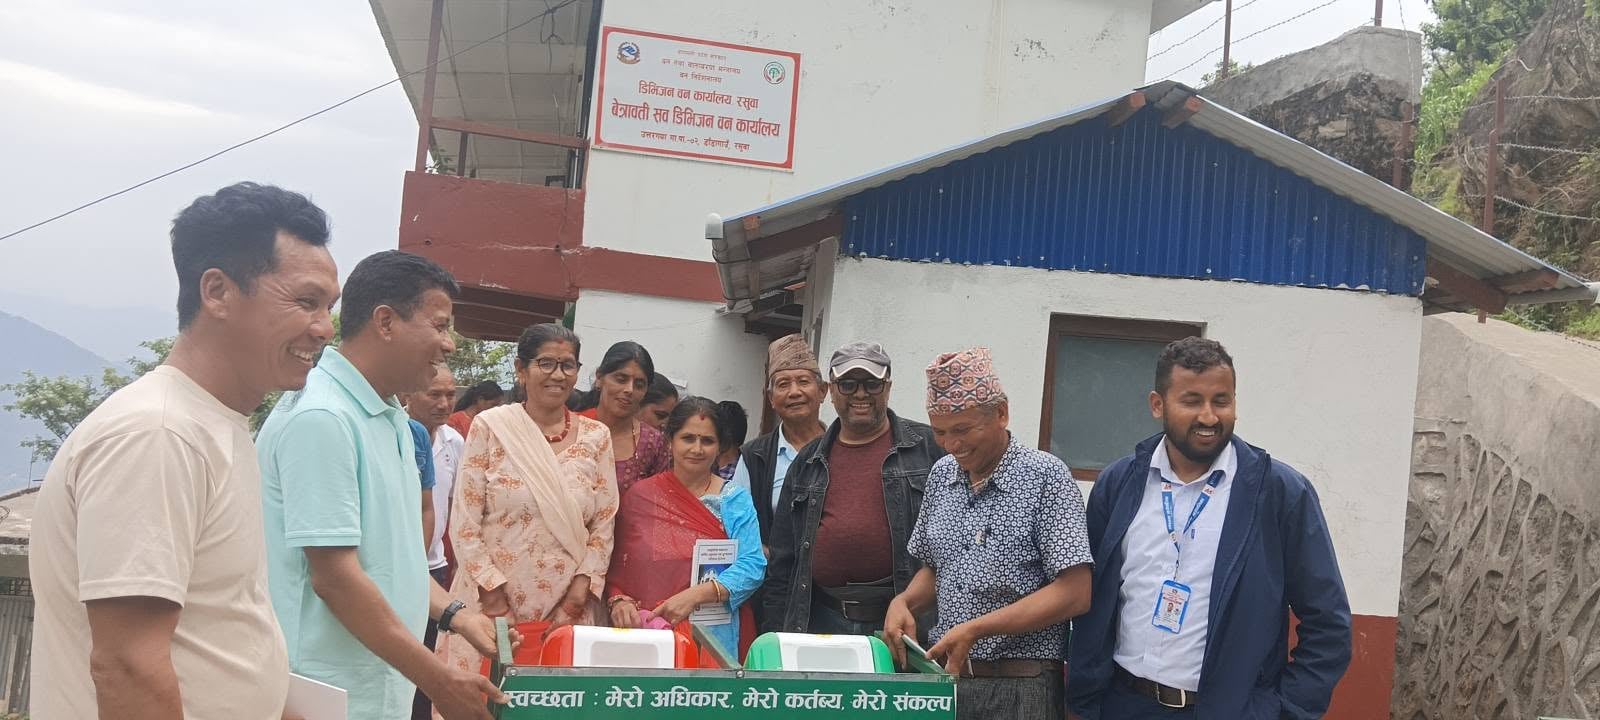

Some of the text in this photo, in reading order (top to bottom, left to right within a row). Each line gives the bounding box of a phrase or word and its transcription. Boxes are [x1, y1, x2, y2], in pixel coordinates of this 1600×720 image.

[638, 80, 759, 110] डिभिजन वन कार्यालय रसुवा
[611, 98, 650, 121] बेत्रावती
[673, 105, 714, 129] डिभिजन
[717, 115, 734, 132] वन
[736, 117, 781, 137] कार्यालय
[504, 689, 586, 709] स्वच्छता
[593, 692, 599, 705] :
[605, 685, 645, 708] मेरो
[742, 686, 780, 710] मेरो
[852, 689, 888, 711] मेरो
[892, 691, 953, 712] संकल्प
